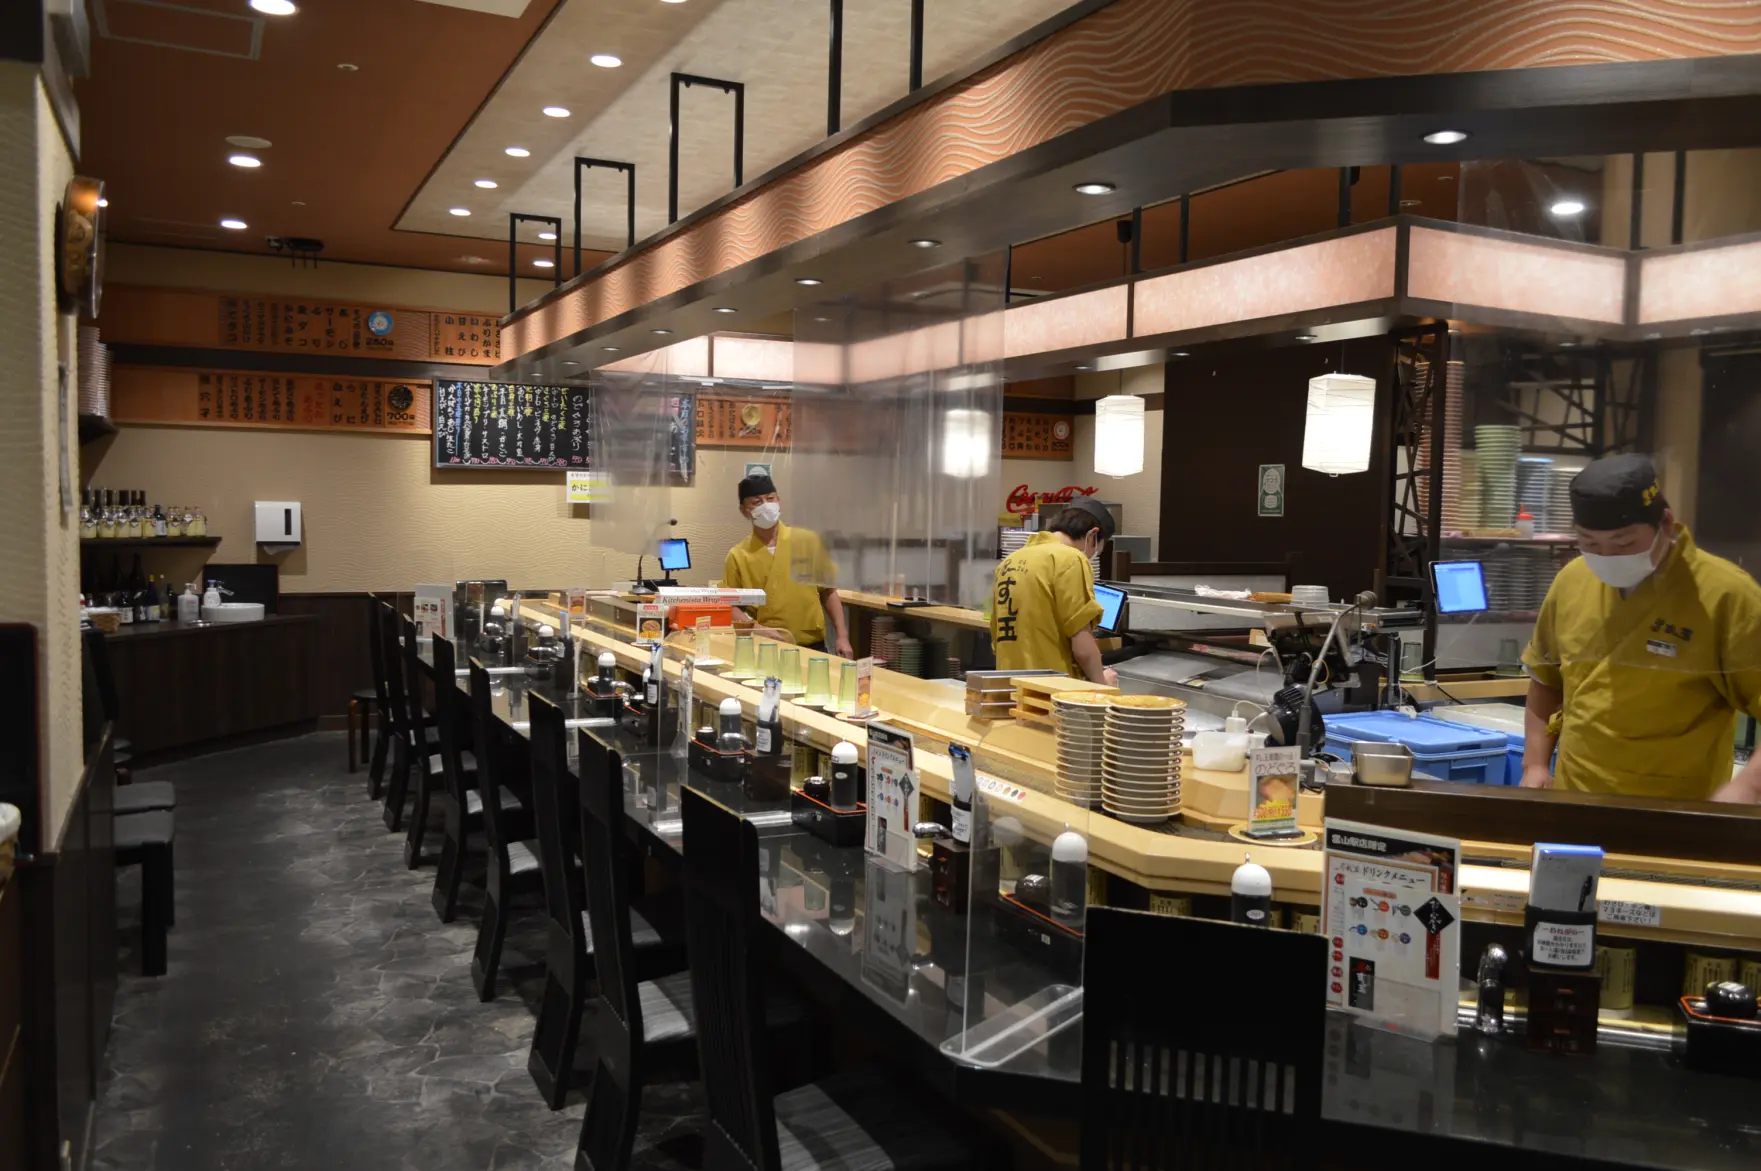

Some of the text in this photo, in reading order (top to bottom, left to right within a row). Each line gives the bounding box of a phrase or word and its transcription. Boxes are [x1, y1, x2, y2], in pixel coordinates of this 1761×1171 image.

[386, 412, 415, 421] 700円
[662, 596, 719, 605] Kitchenista Wrap
[997, 577, 1019, 642] すし玉
[1362, 866, 1425, 884] ドリンクメニュー
